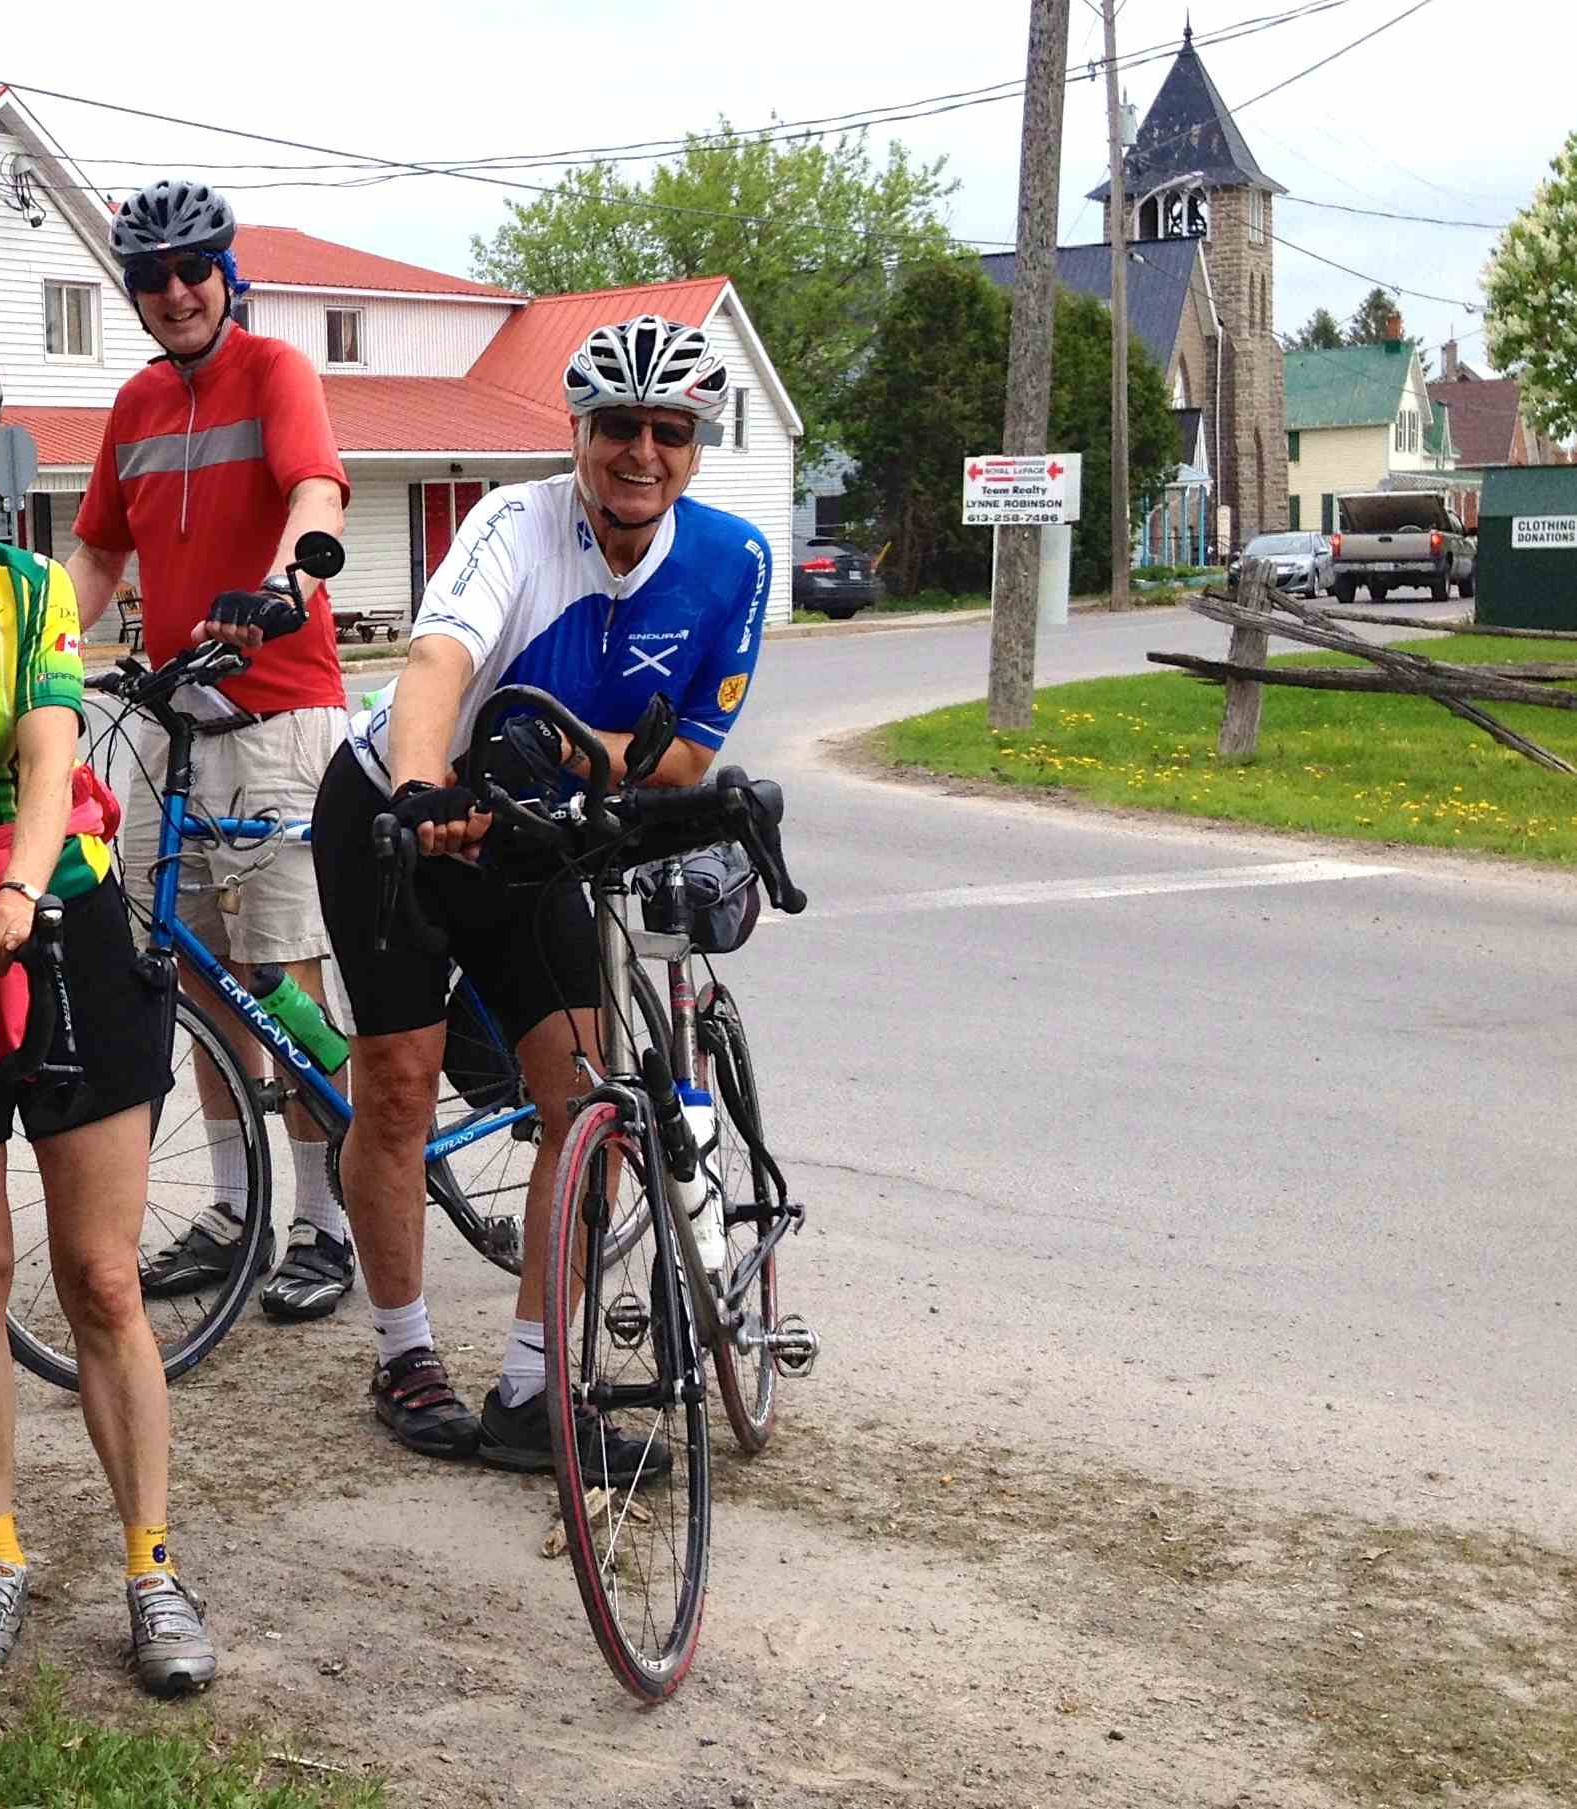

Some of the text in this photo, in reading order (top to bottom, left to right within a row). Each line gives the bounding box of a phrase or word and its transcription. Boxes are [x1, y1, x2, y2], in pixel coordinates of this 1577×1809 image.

[981, 484, 1047, 496] Team Realty
[966, 499, 1063, 509] LYNNE ROBINSON
[1518, 520, 1576, 532] CLOTHING
[1518, 533, 1576, 543] DONATIONS
[450, 500, 525, 597] SCOTLAND
[736, 539, 766, 654] ENDURA
[628, 631, 685, 640] ENDURA
